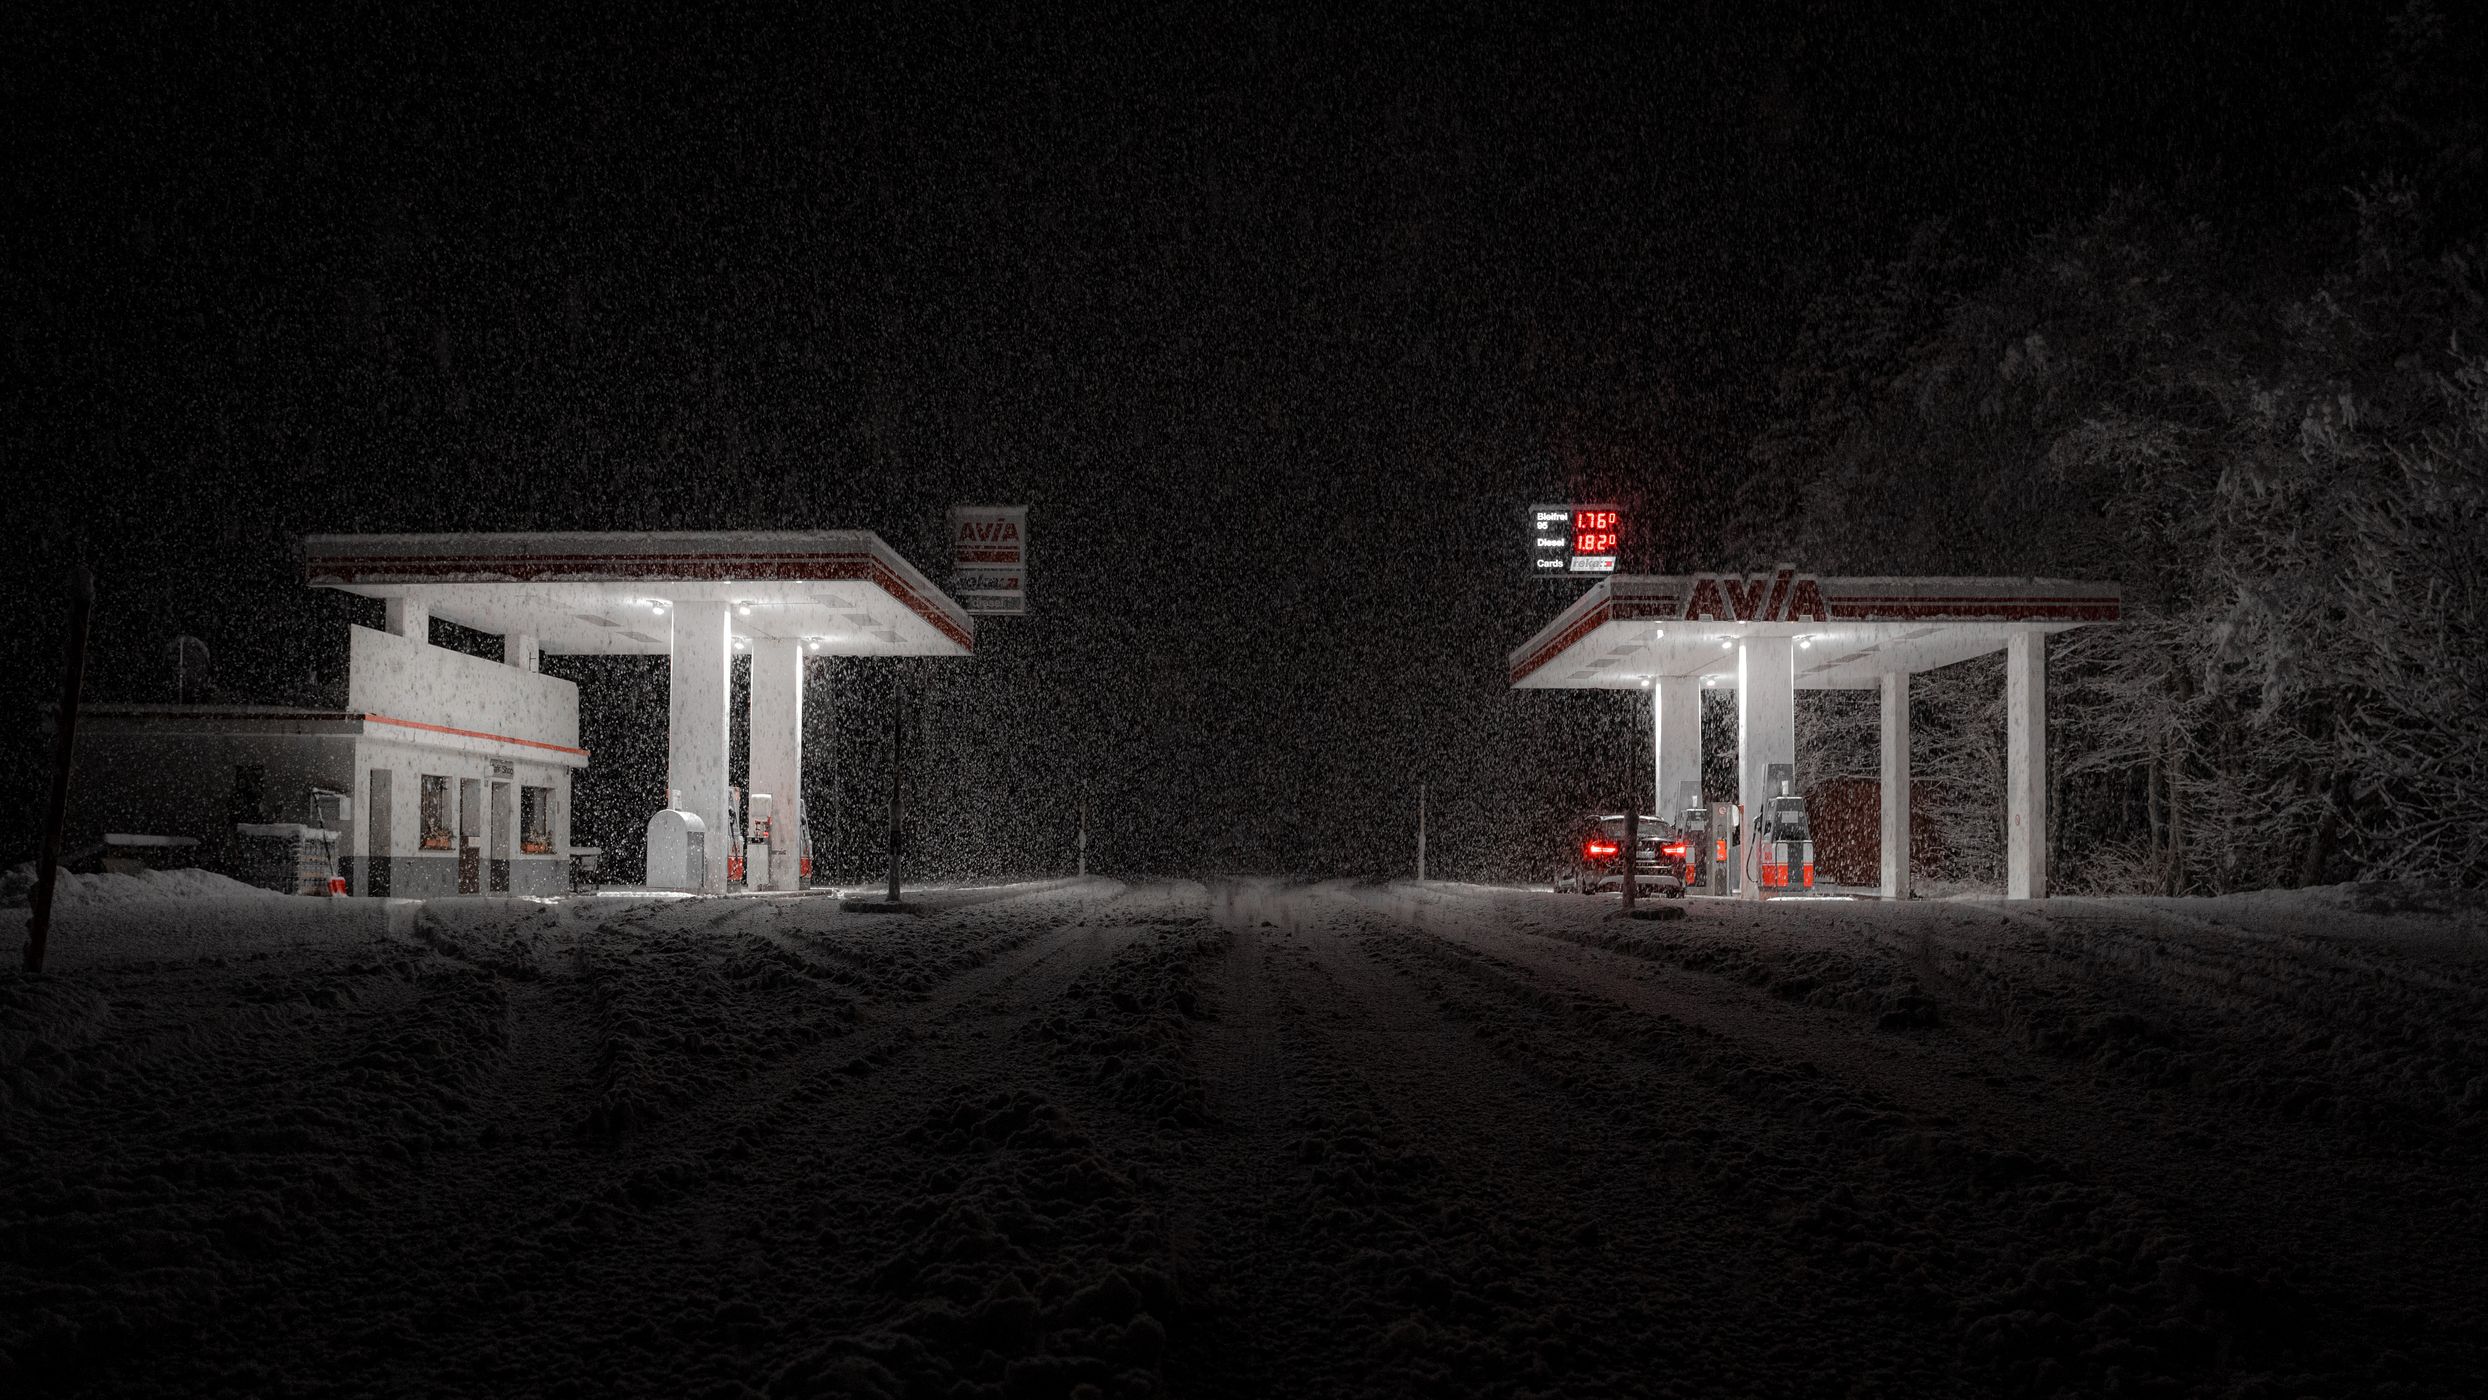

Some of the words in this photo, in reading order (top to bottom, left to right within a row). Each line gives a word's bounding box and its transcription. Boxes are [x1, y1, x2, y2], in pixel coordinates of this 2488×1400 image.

[1537, 512, 1568, 520] Bleifrei
[959, 518, 1020, 542] AVIA
[1537, 522, 1548, 530] 95
[1537, 538, 1565, 547] Diesel
[1537, 559, 1564, 568] Cards
[1684, 568, 1827, 622] AVIA
